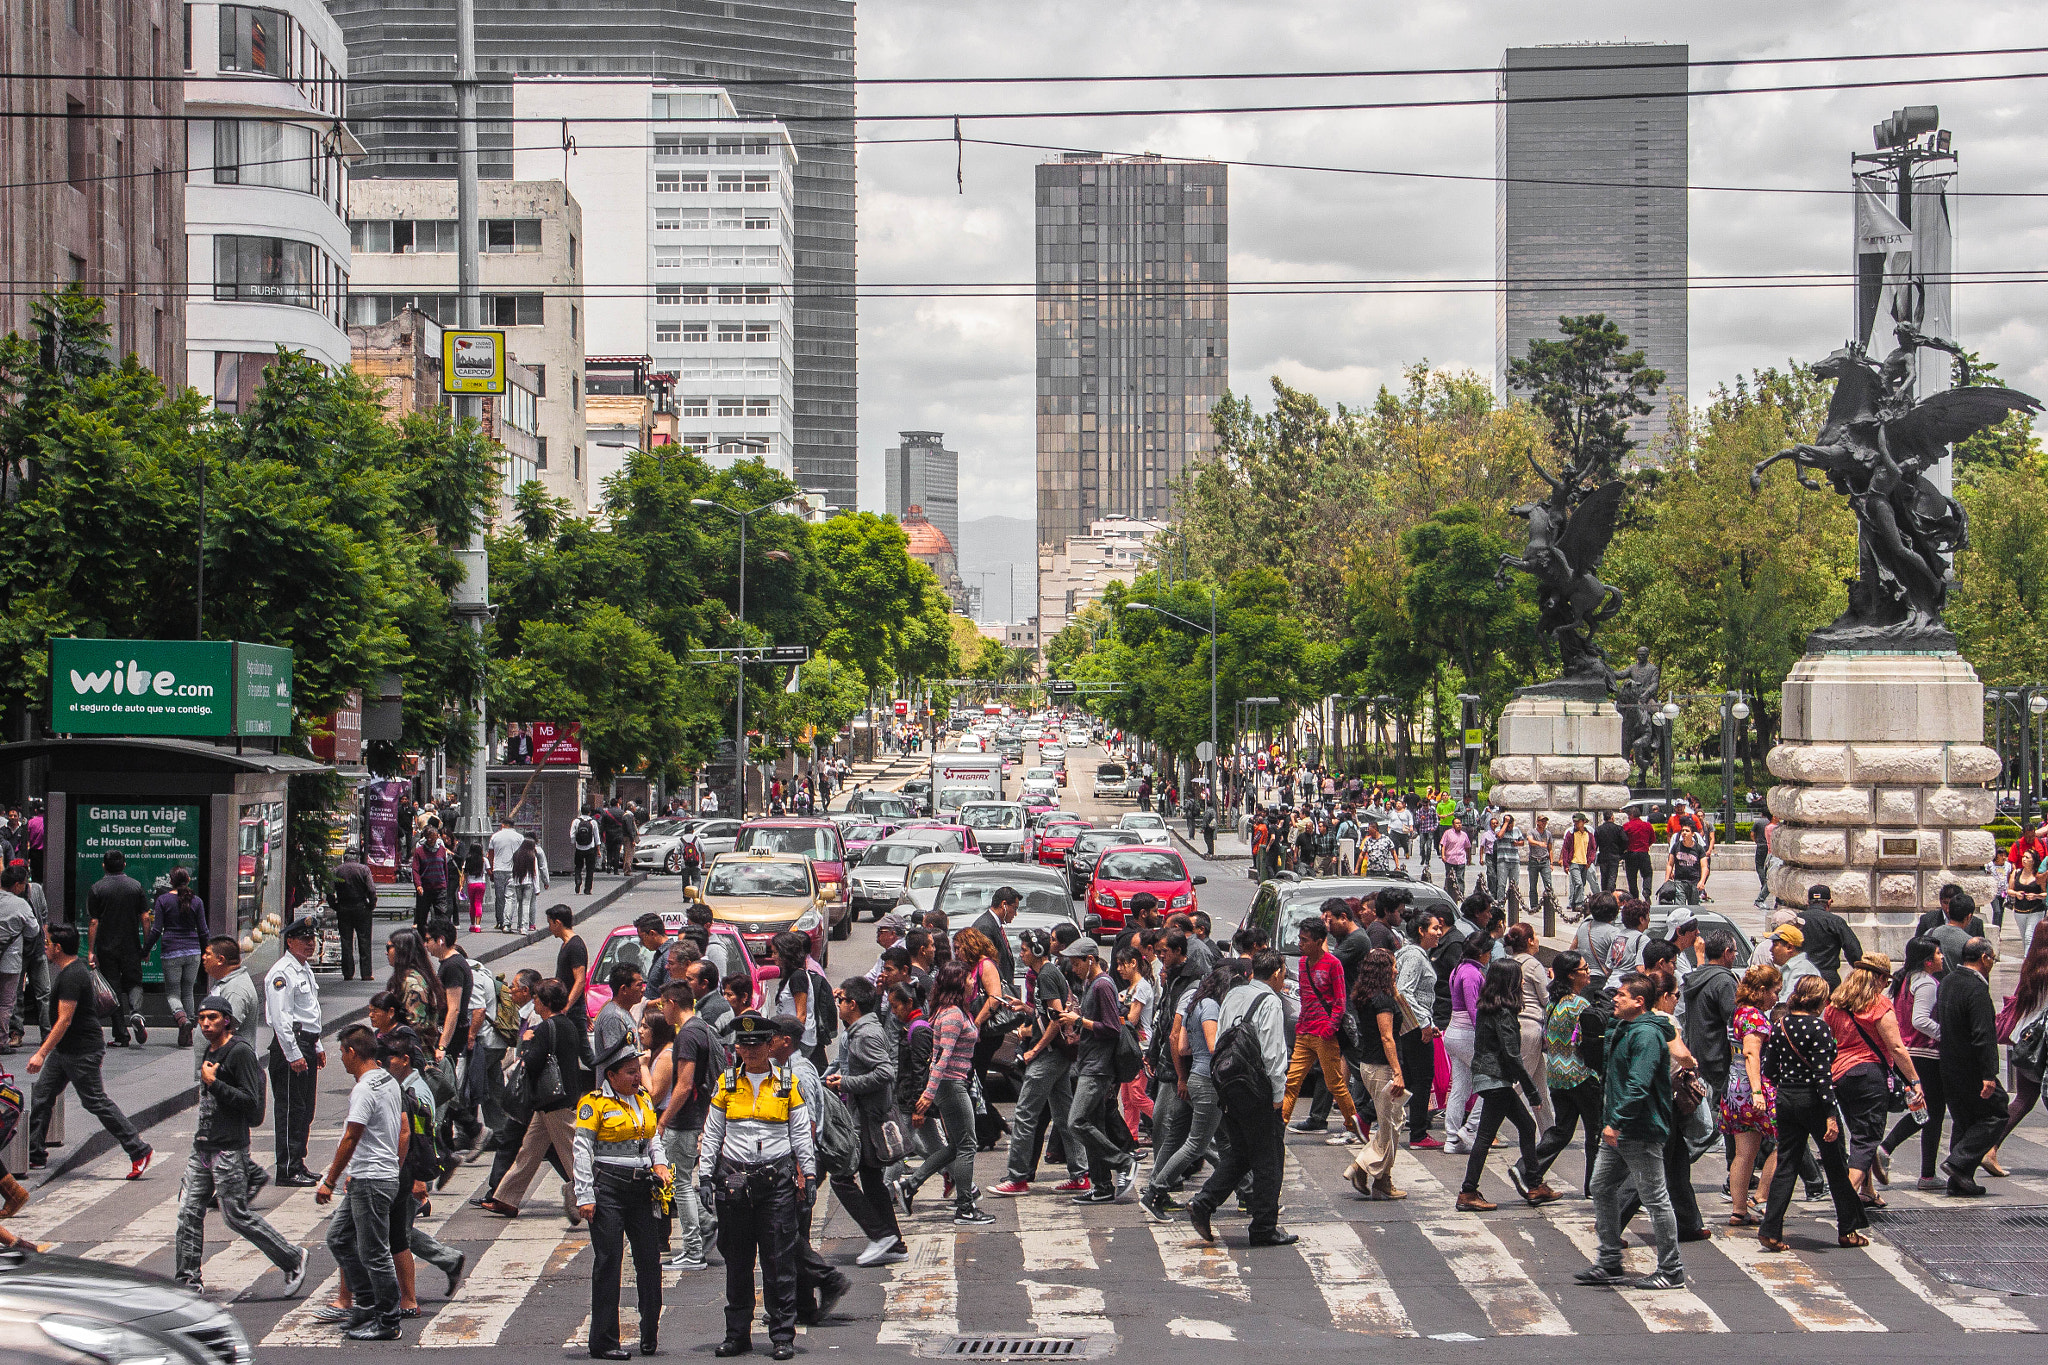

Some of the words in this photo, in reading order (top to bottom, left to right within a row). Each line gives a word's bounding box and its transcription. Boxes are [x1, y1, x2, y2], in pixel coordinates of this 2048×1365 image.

[69, 703, 78, 712] el
[80, 704, 110, 713] seguro
[111, 703, 123, 712] de
[124, 704, 145, 713] auto
[147, 705, 164, 714] que
[177, 704, 213, 715] contigo.
[540, 727, 554, 735] MB
[89, 807, 127, 820] Gana
[130, 810, 149, 820] un
[151, 807, 187, 823] viaje
[100, 824, 110, 833] al
[112, 824, 142, 834] Space
[143, 824, 177, 834] Center
[86, 837, 99, 847] de
[101, 837, 142, 847] Houston
[143, 839, 162, 847] con
[163, 838, 190, 847] wibe.
[751, 848, 770, 856] TAXI
[661, 914, 681, 922] TAXI
